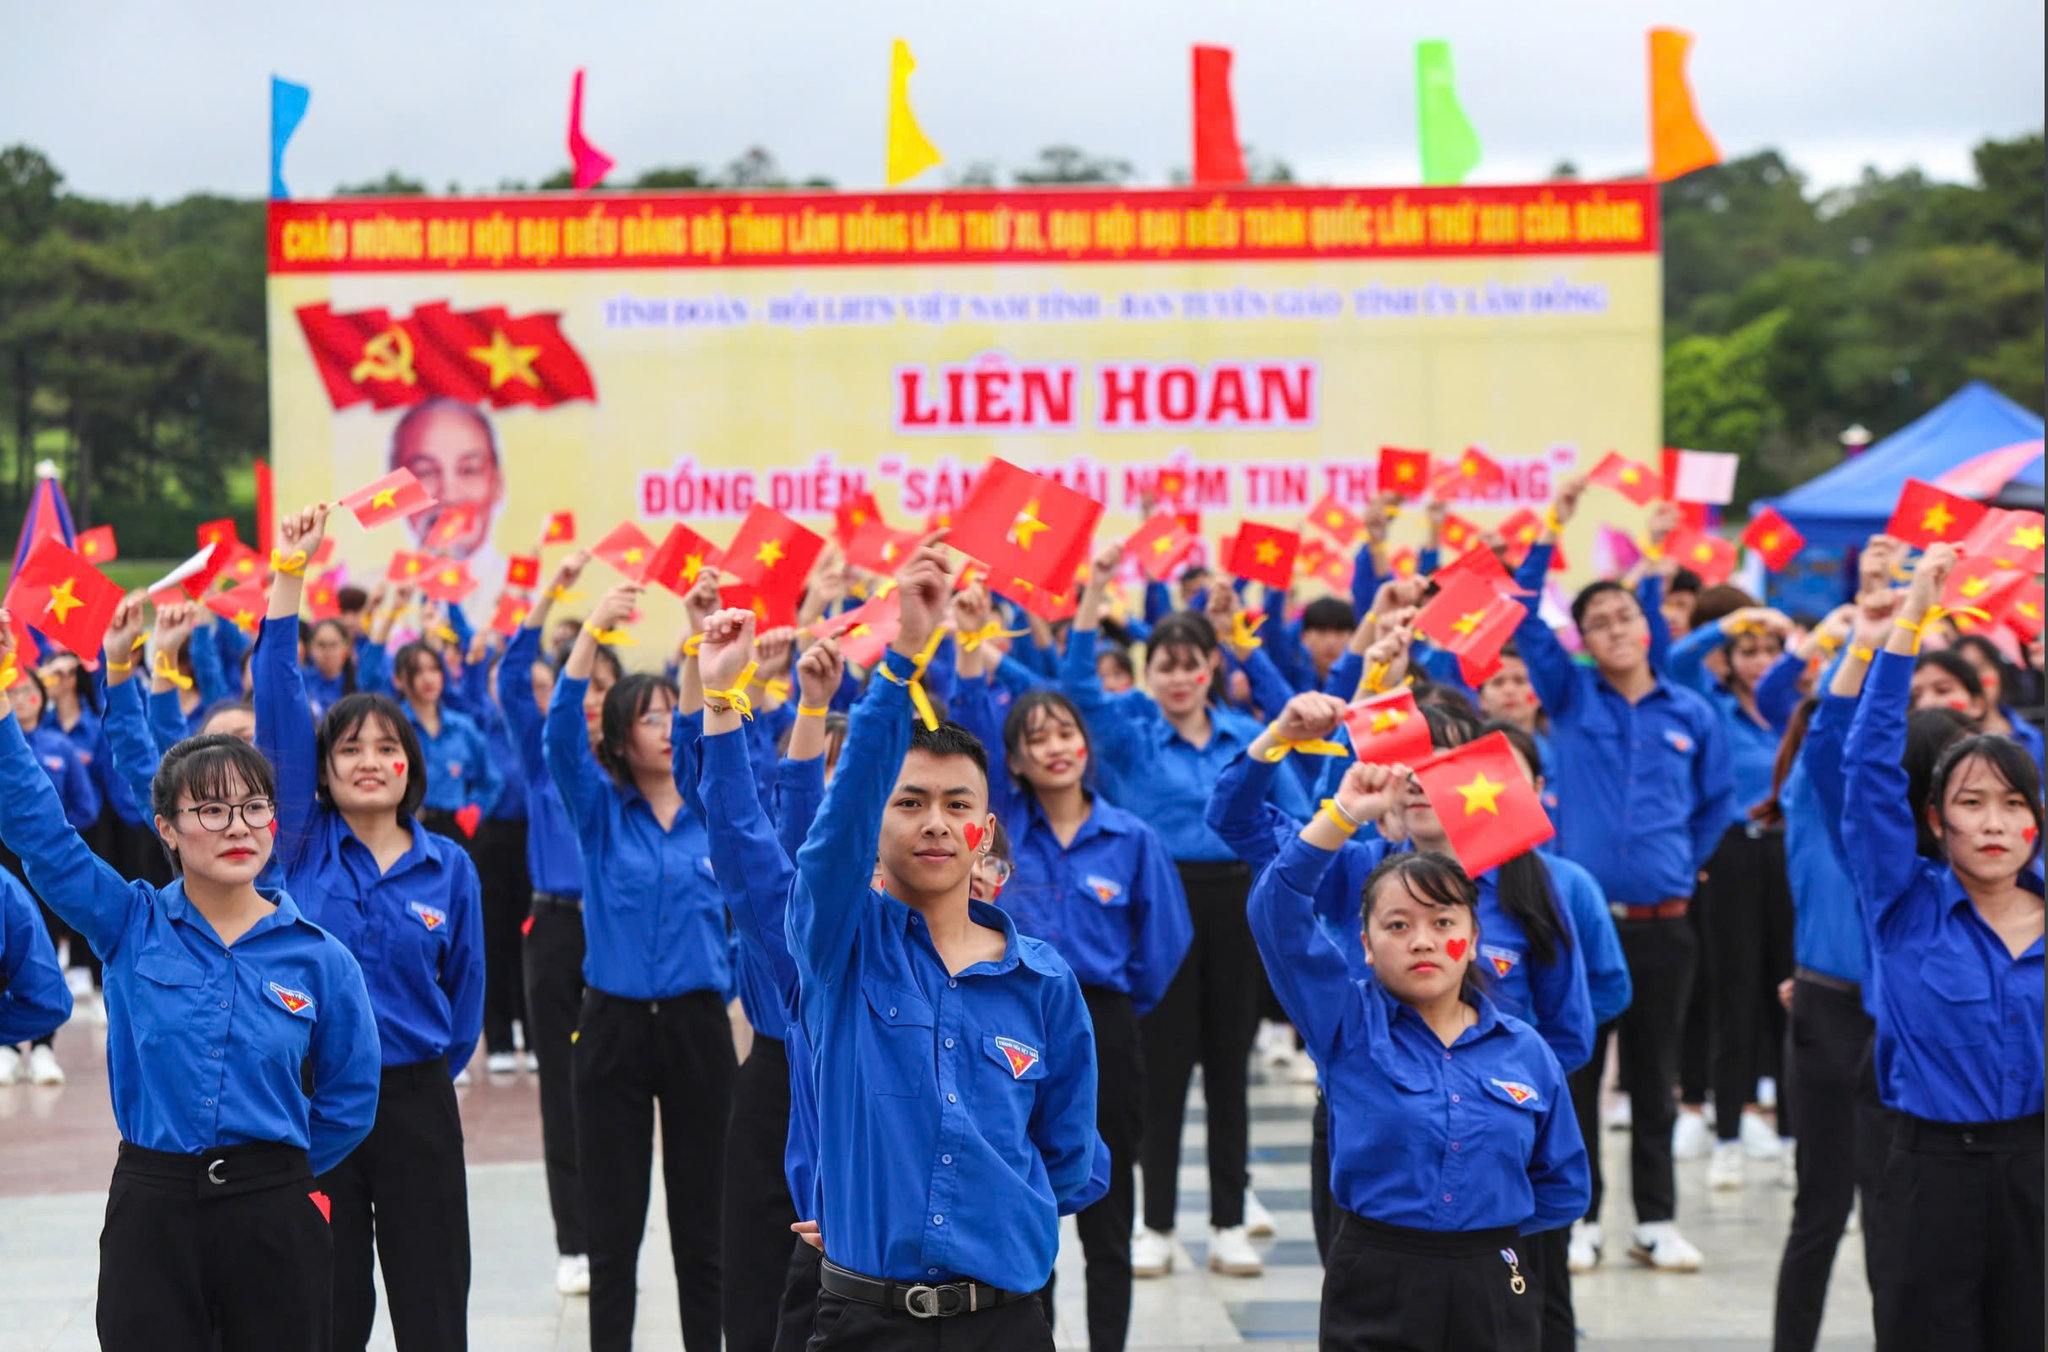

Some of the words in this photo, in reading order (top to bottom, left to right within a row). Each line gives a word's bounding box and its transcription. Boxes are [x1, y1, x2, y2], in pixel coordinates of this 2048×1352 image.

[900, 353, 1074, 426] LIÊN
[1102, 367, 1313, 422] HOAN
[1247, 467, 1306, 503] TIN
